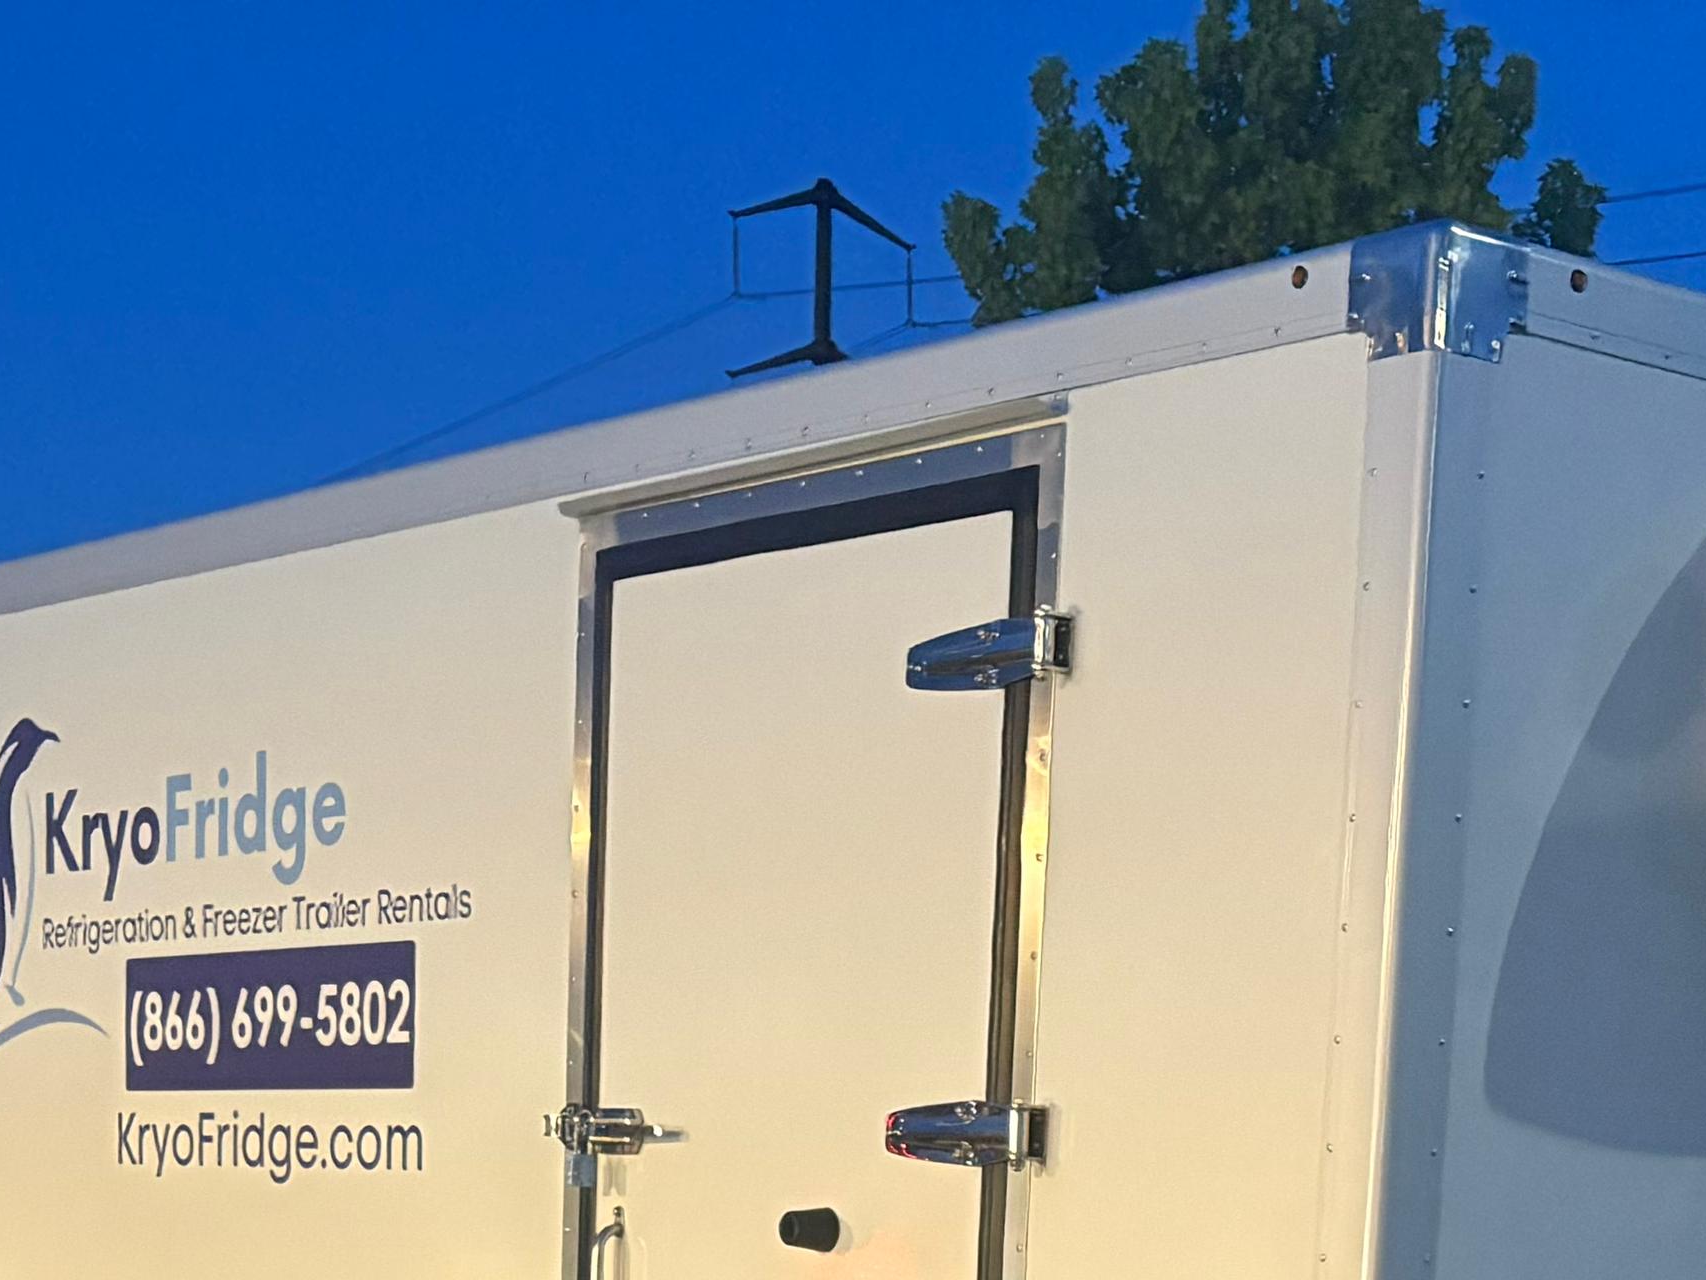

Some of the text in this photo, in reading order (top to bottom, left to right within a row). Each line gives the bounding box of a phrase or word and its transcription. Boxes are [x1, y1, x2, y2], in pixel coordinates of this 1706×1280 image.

[45, 750, 347, 902] KryoFridge
[42, 883, 473, 954] Refrigeration & Freezer Trailer Rentals
[130, 979, 411, 1067] (866) 699-5802
[117, 1109, 424, 1184] KryoFridge.com
